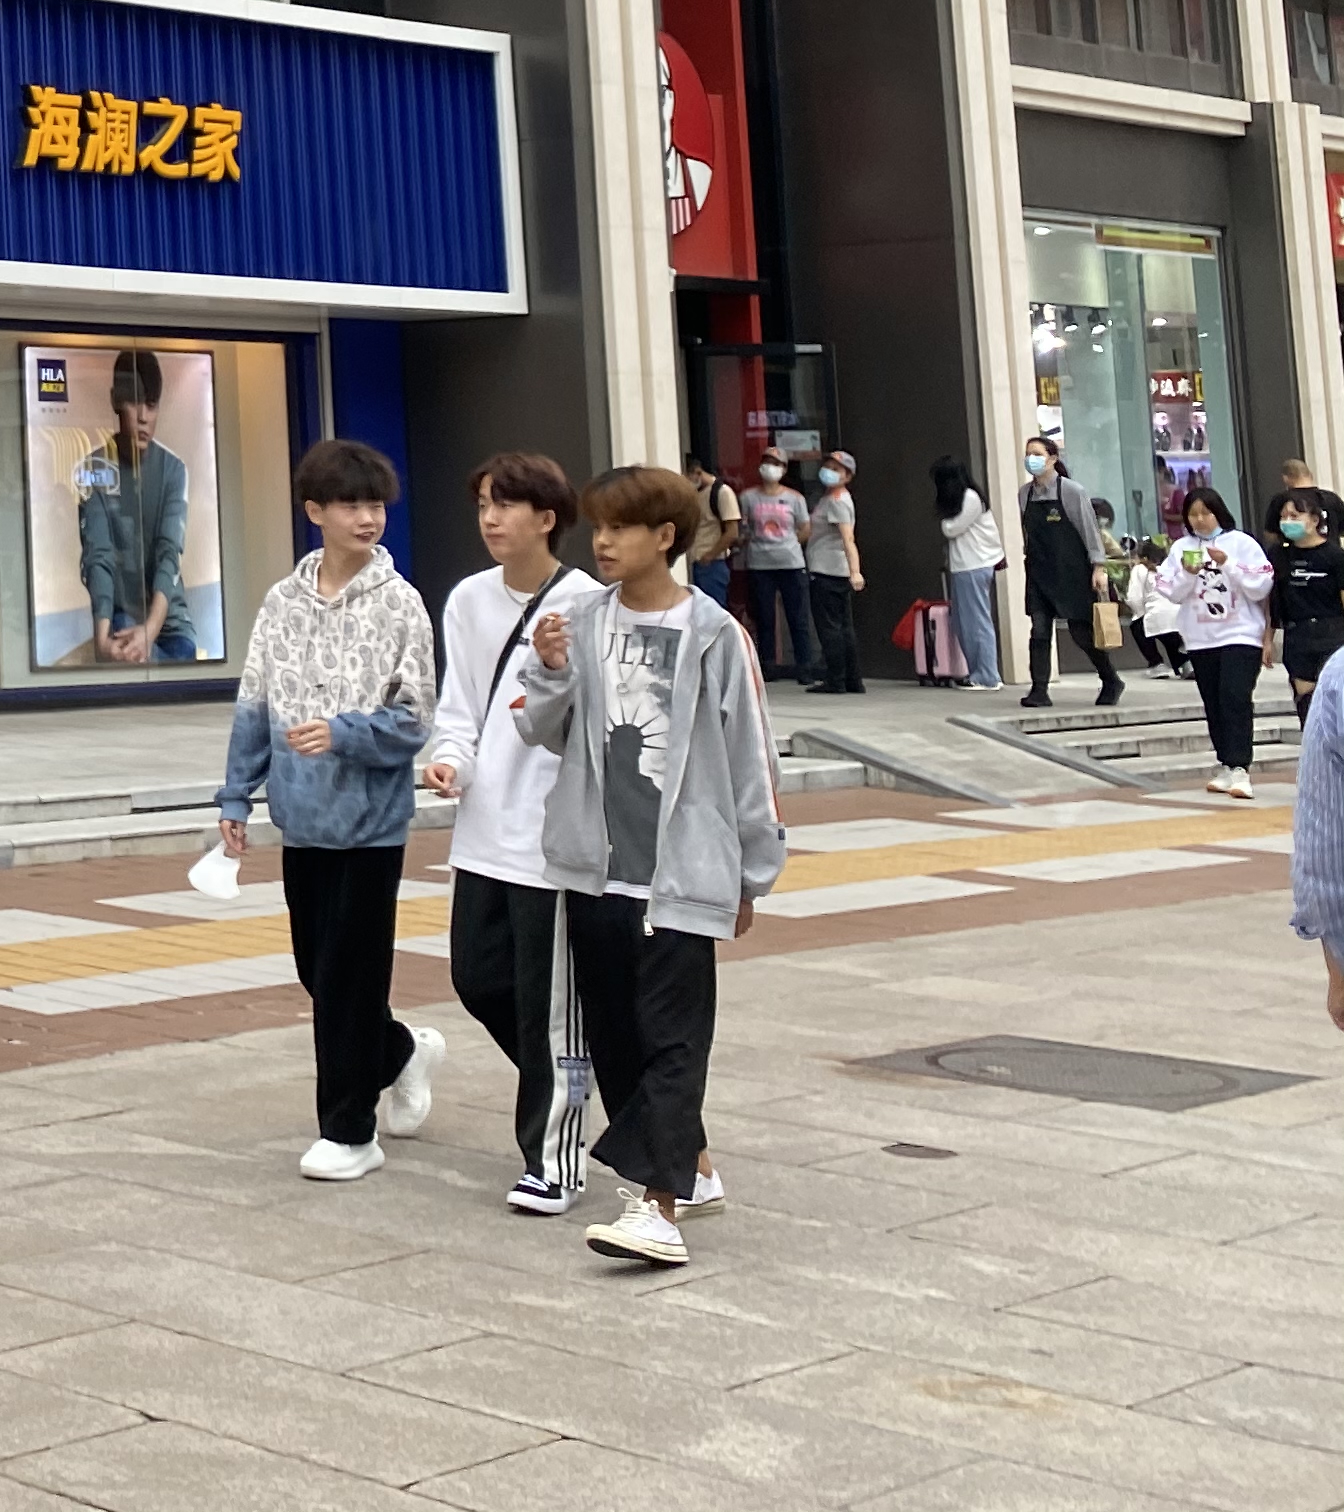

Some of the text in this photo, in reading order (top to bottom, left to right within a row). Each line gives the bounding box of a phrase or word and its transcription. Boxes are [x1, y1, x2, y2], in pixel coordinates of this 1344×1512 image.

[21, 84, 243, 184] 海澜之家
[41, 368, 65, 382] HLA
